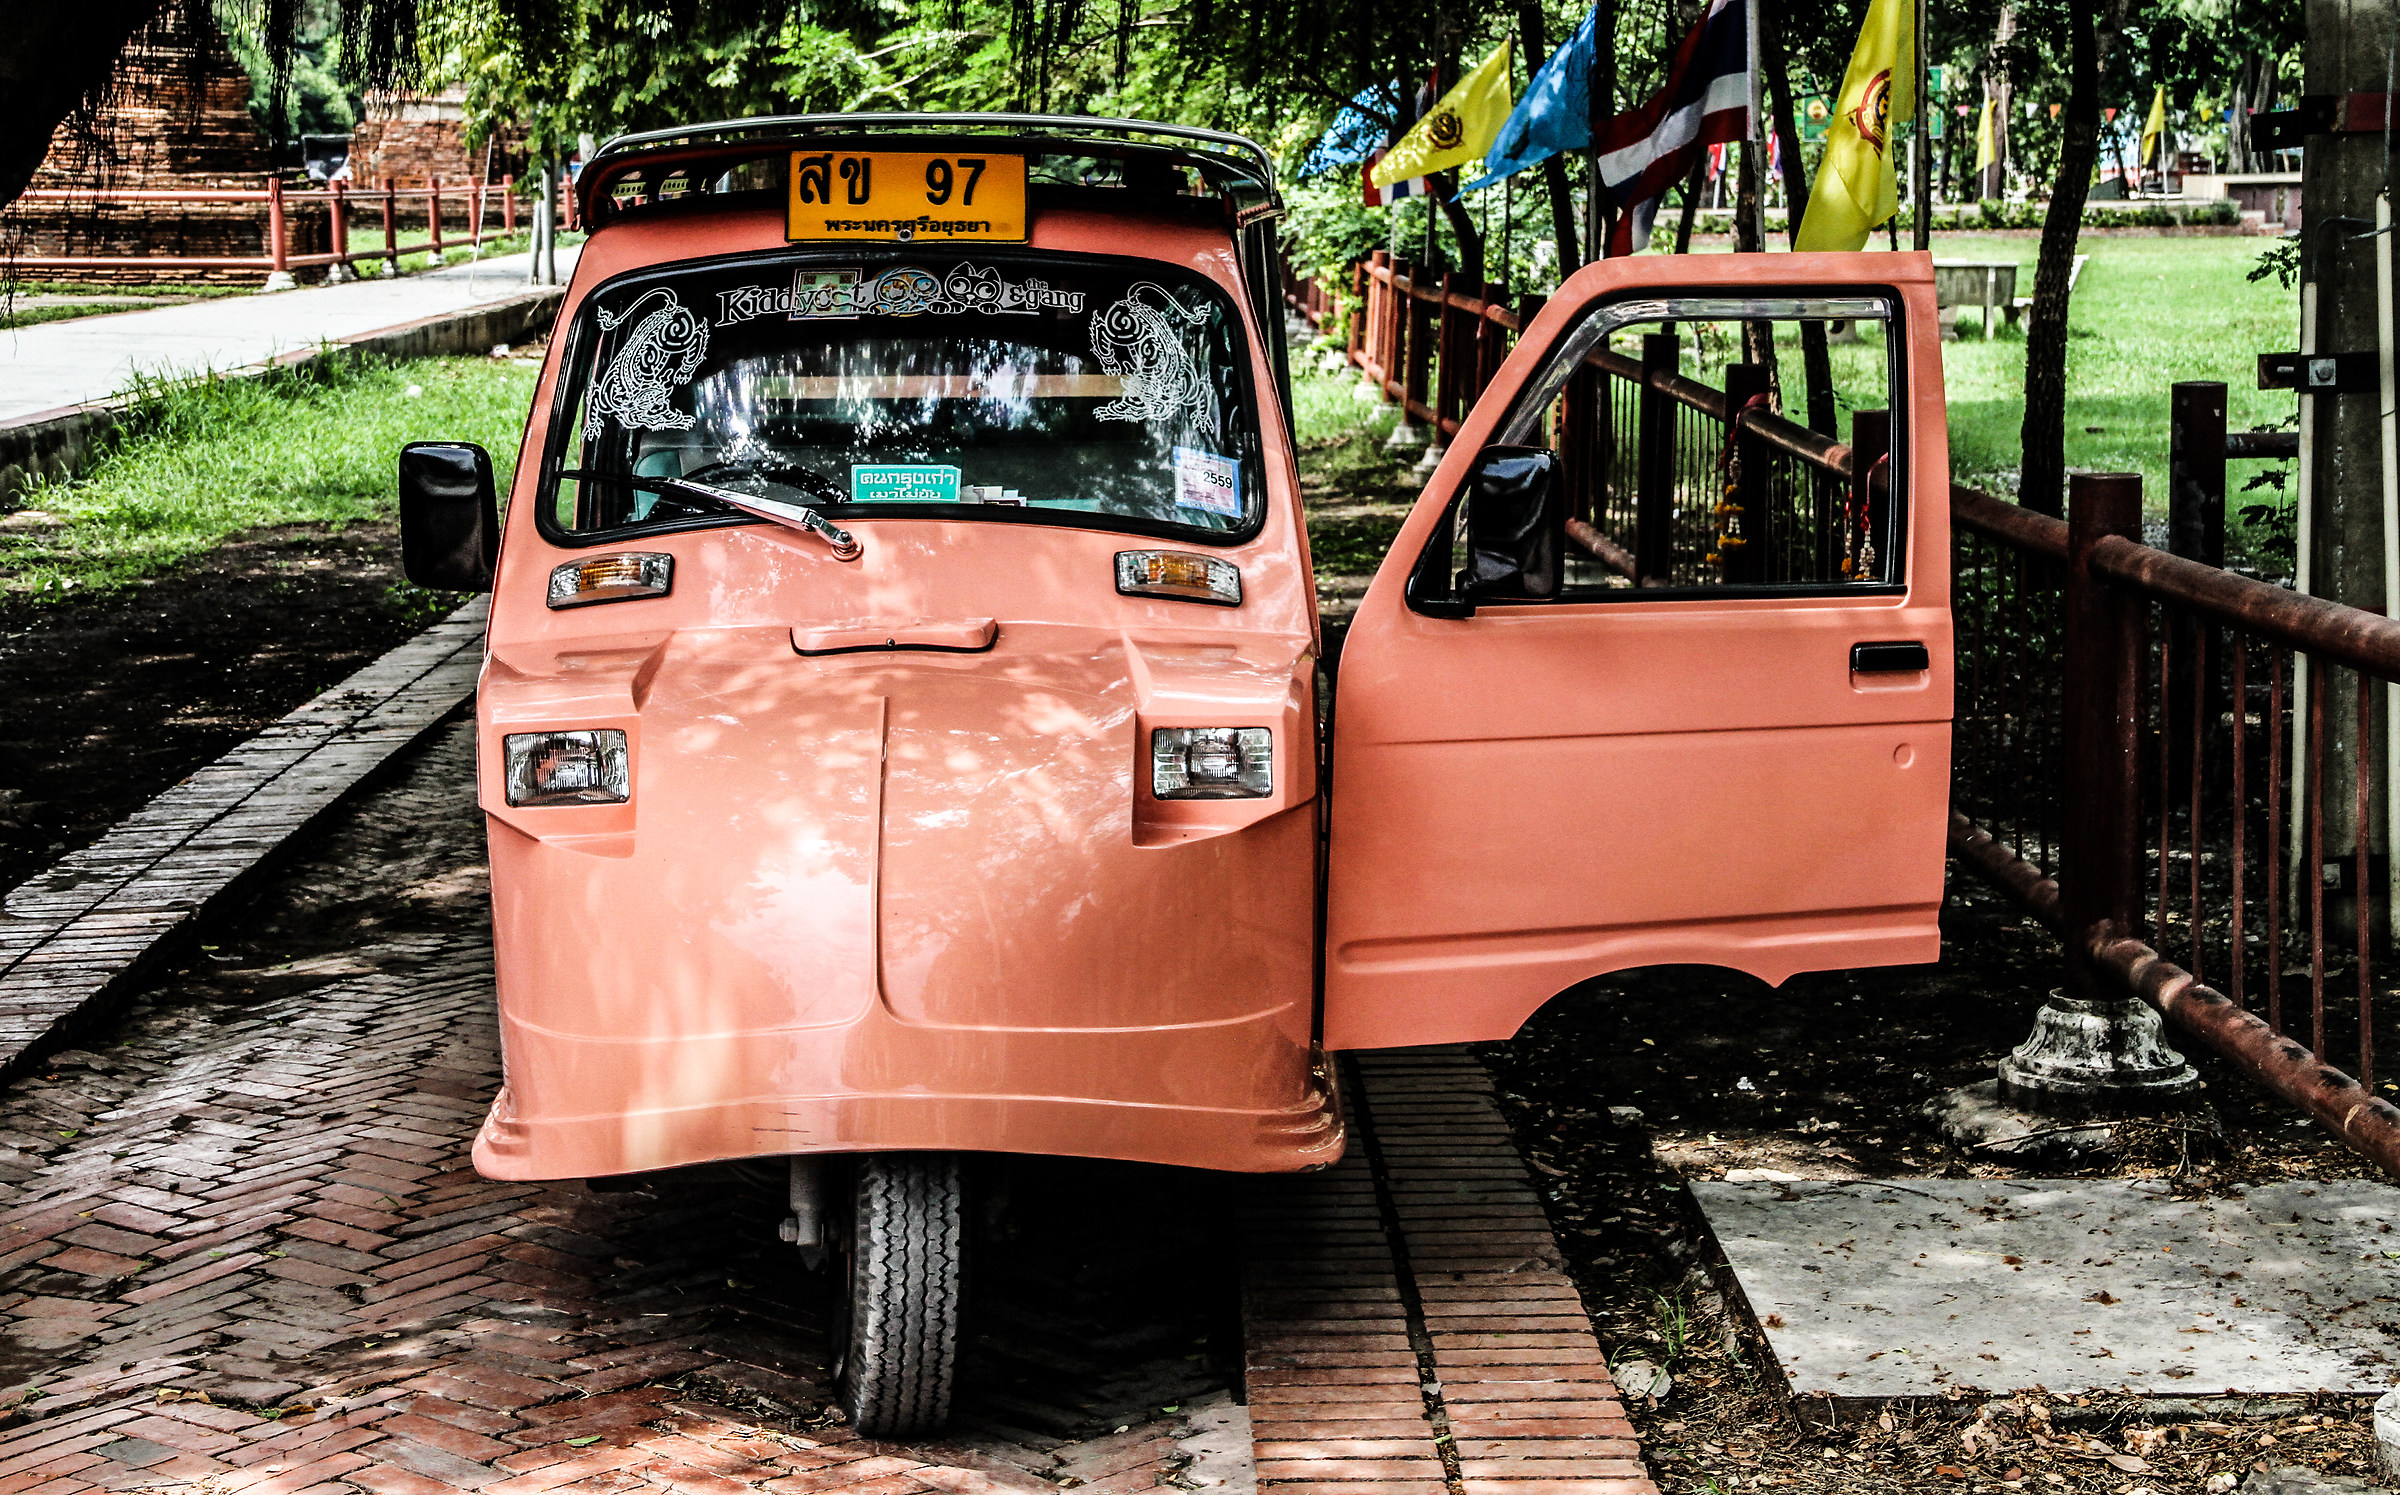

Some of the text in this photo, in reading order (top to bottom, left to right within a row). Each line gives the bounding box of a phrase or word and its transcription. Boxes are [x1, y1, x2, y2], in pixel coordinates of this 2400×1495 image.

[798, 153, 987, 206] สข 97
[824, 215, 991, 237] พระนครศรีอยุธยา
[1026, 278, 1048, 291] the
[1025, 289, 1086, 314] gang
[1203, 471, 1233, 489] 2559
